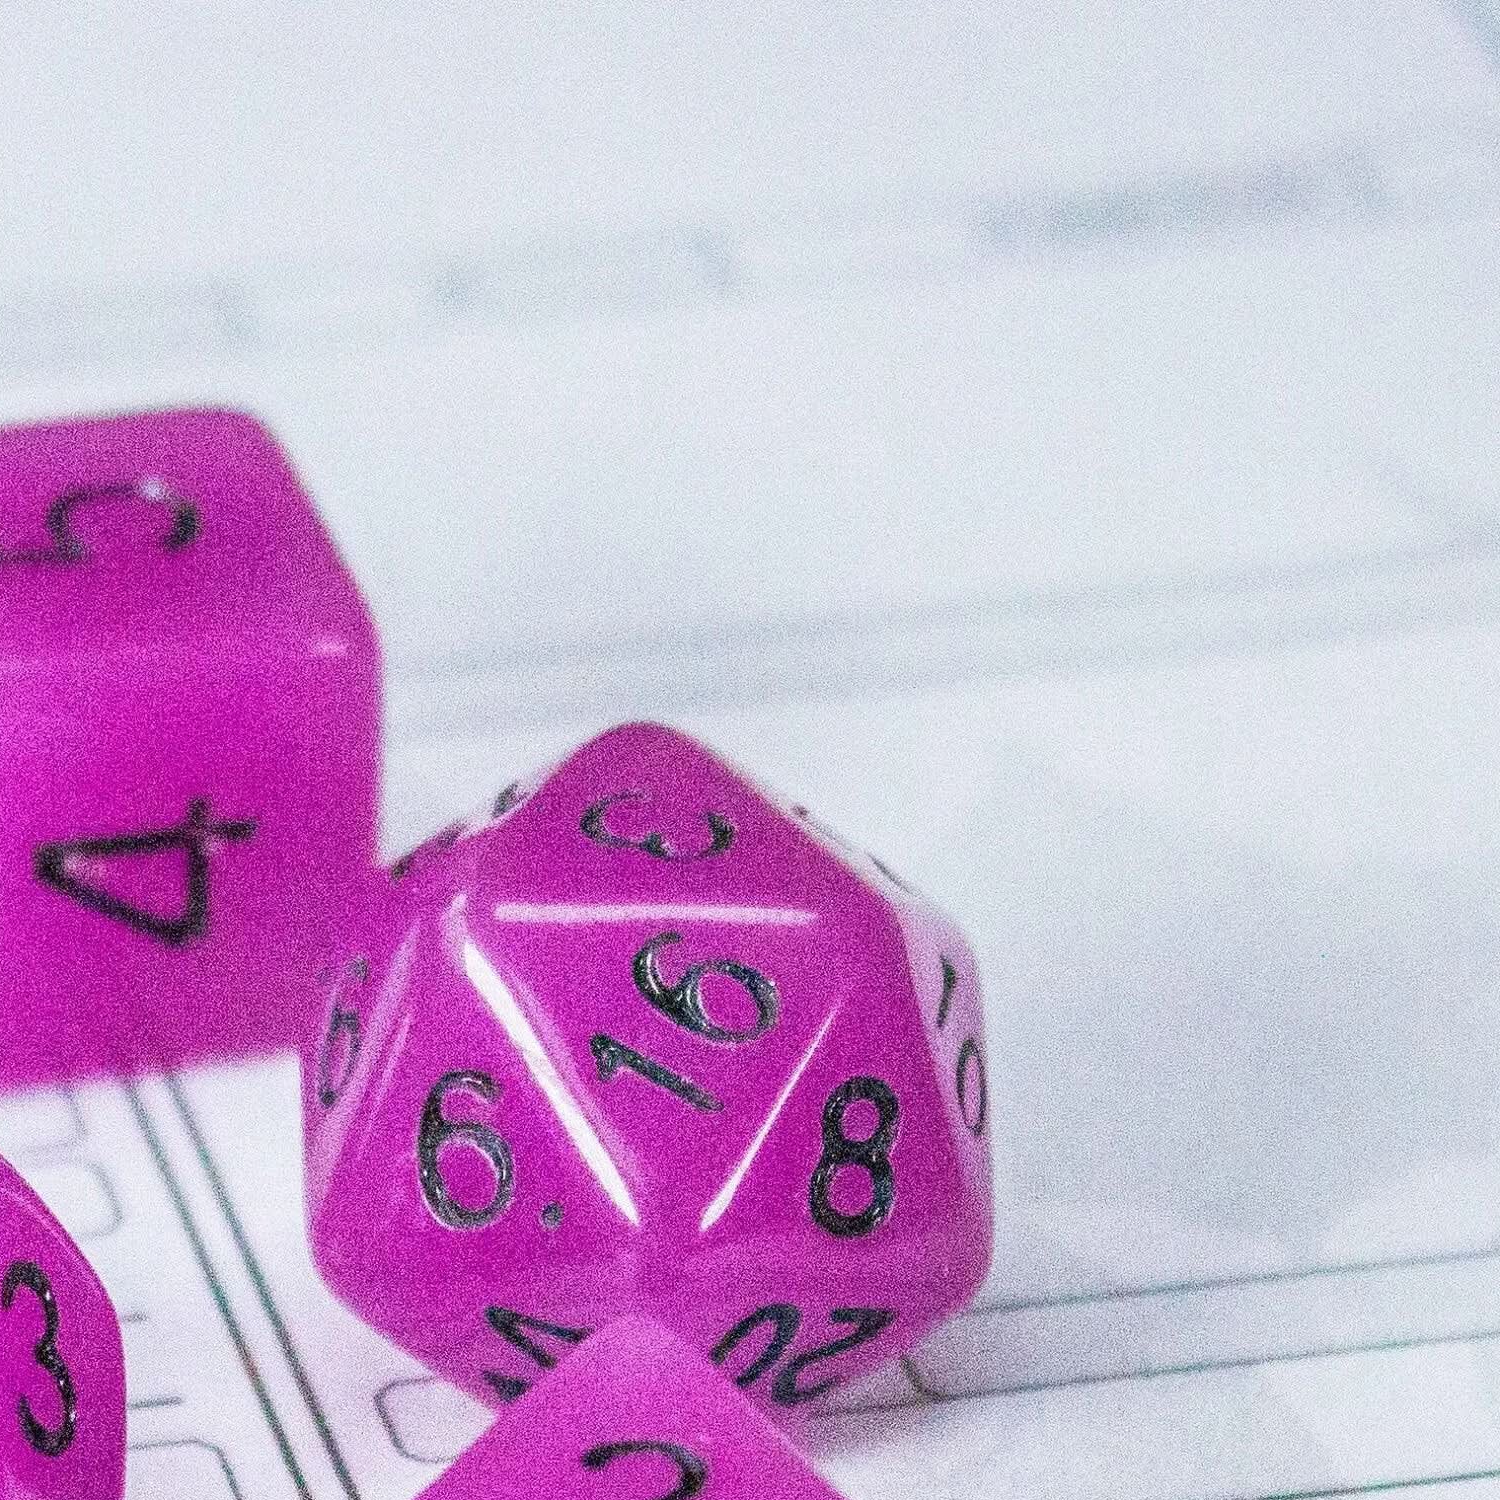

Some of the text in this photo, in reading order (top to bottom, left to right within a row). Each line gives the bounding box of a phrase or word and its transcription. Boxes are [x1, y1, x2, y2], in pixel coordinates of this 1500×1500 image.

[32, 796, 258, 949] 4
[579, 790, 738, 862] 3
[589, 931, 780, 1113] 16
[809, 1075, 899, 1238] 8
[1, 1260, 78, 1457] 3
